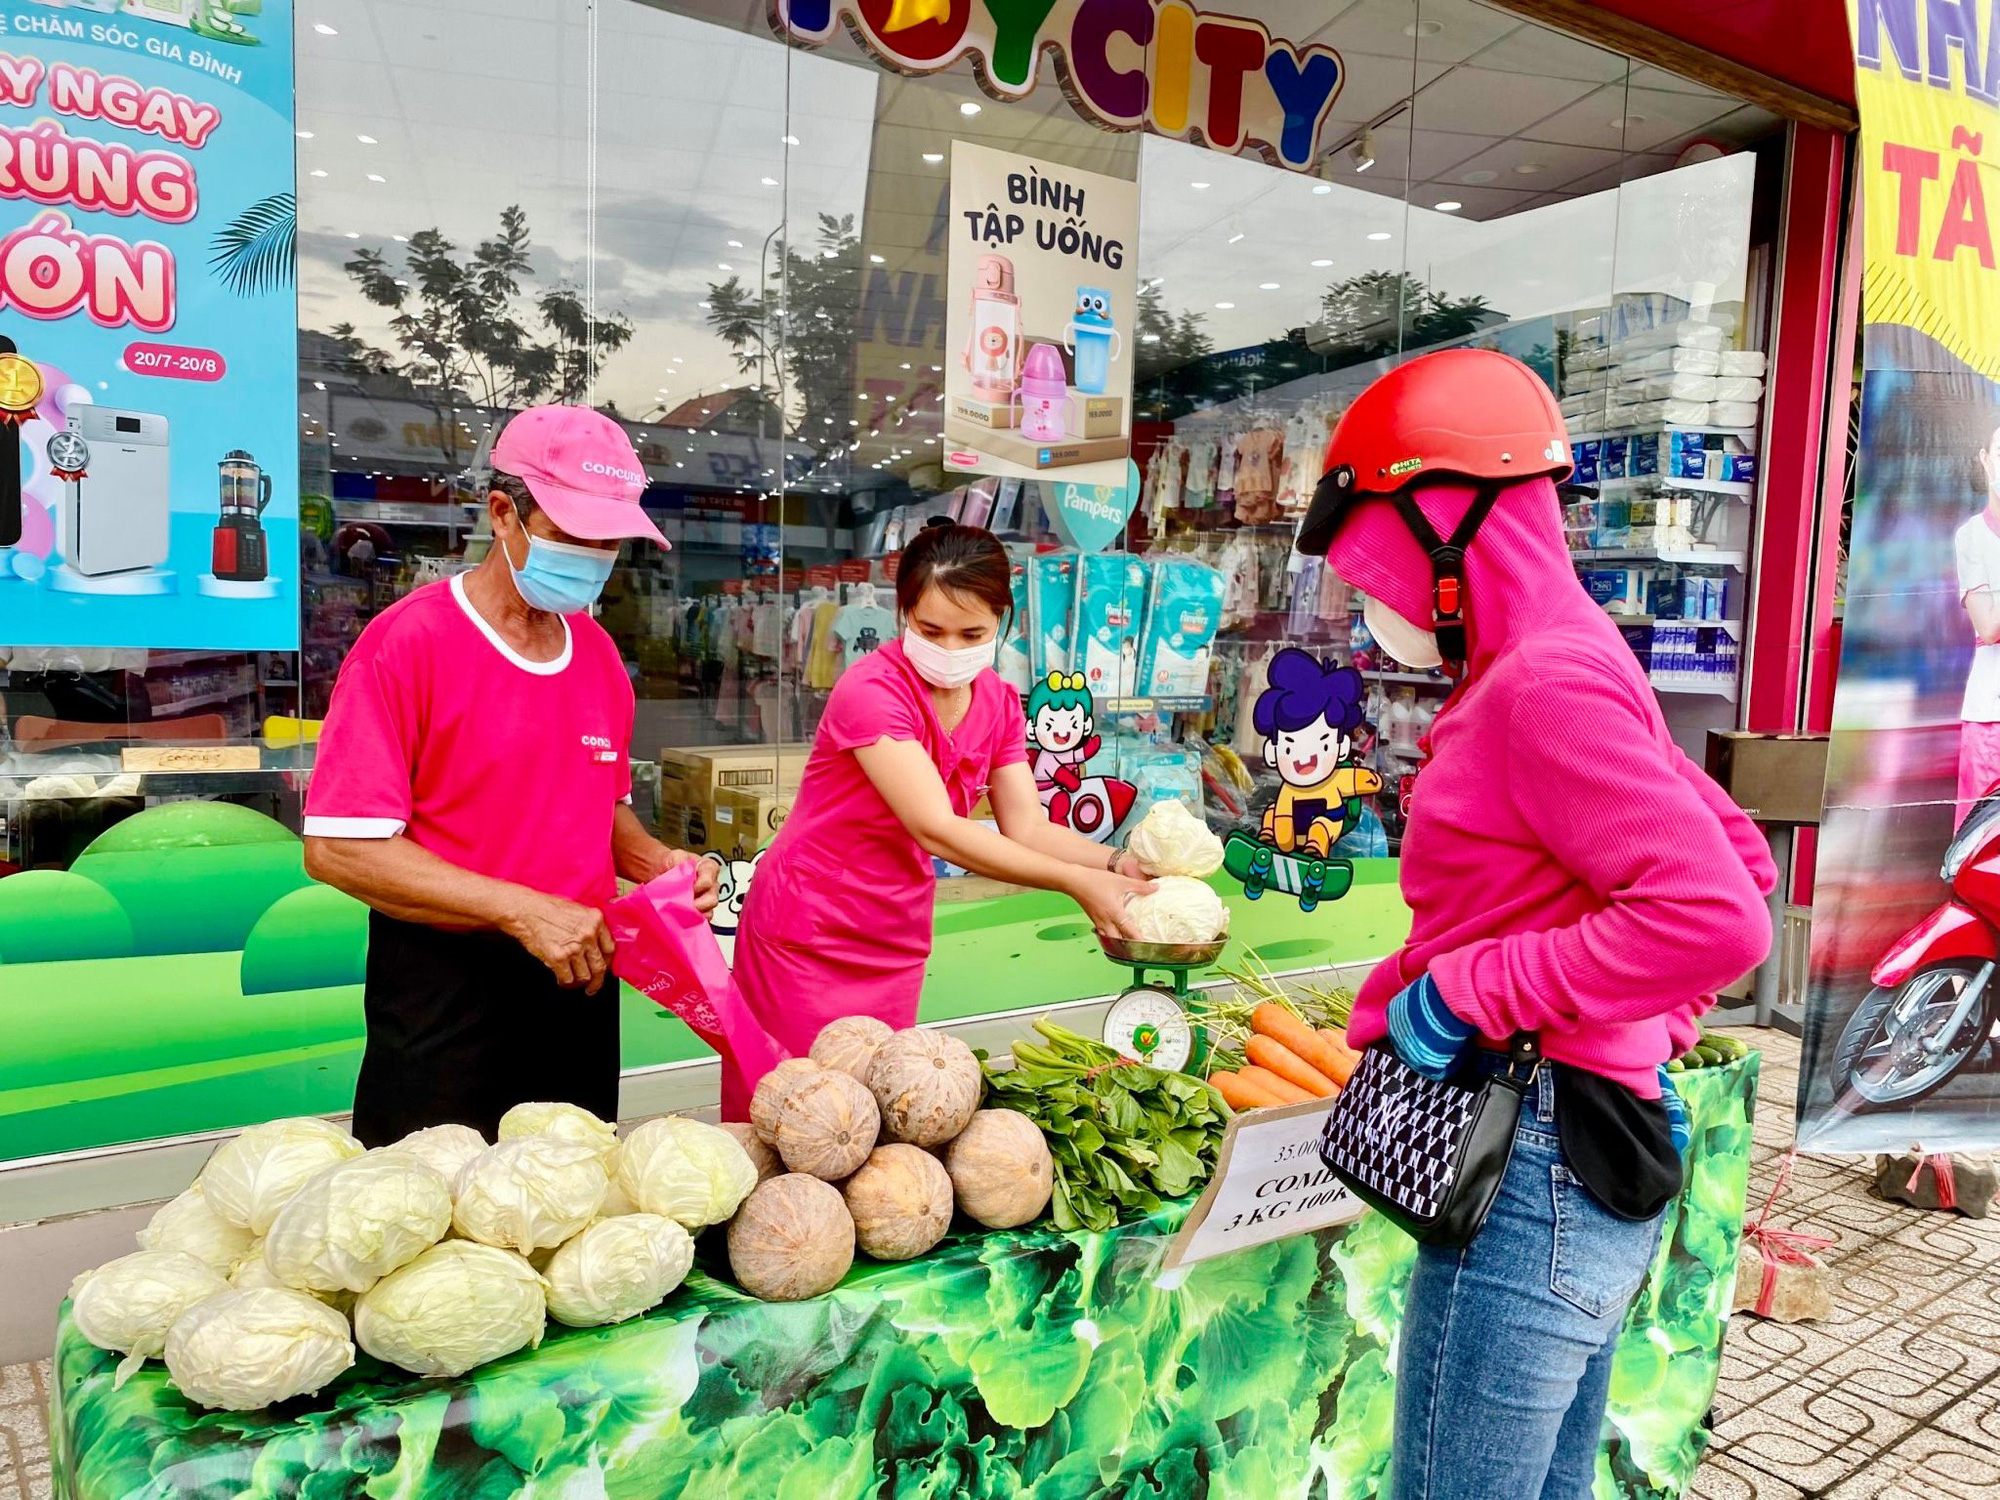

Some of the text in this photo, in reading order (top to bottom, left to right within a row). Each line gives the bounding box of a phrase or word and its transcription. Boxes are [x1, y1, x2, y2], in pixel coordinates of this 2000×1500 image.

[14, 13, 84, 39] CHĂM
[90, 23, 139, 49] SÓC
[145, 37, 183, 63] GIA
[188, 50, 243, 85] ĐÌNH
[1857, 0, 2000, 110] NH
[55, 68, 214, 143] NGAY
[1007, 164, 1086, 218] BÌNH
[1882, 125, 1997, 270] TÃ
[963, 202, 1025, 250] TẬP
[1035, 216, 1124, 271] UỐNG
[133, 350, 218, 374] 20/7-20/8
[581, 461, 641, 483] concung
[1064, 483, 1122, 524] Pampers
[1223, 1186, 1349, 1232] 3 KG 100K
